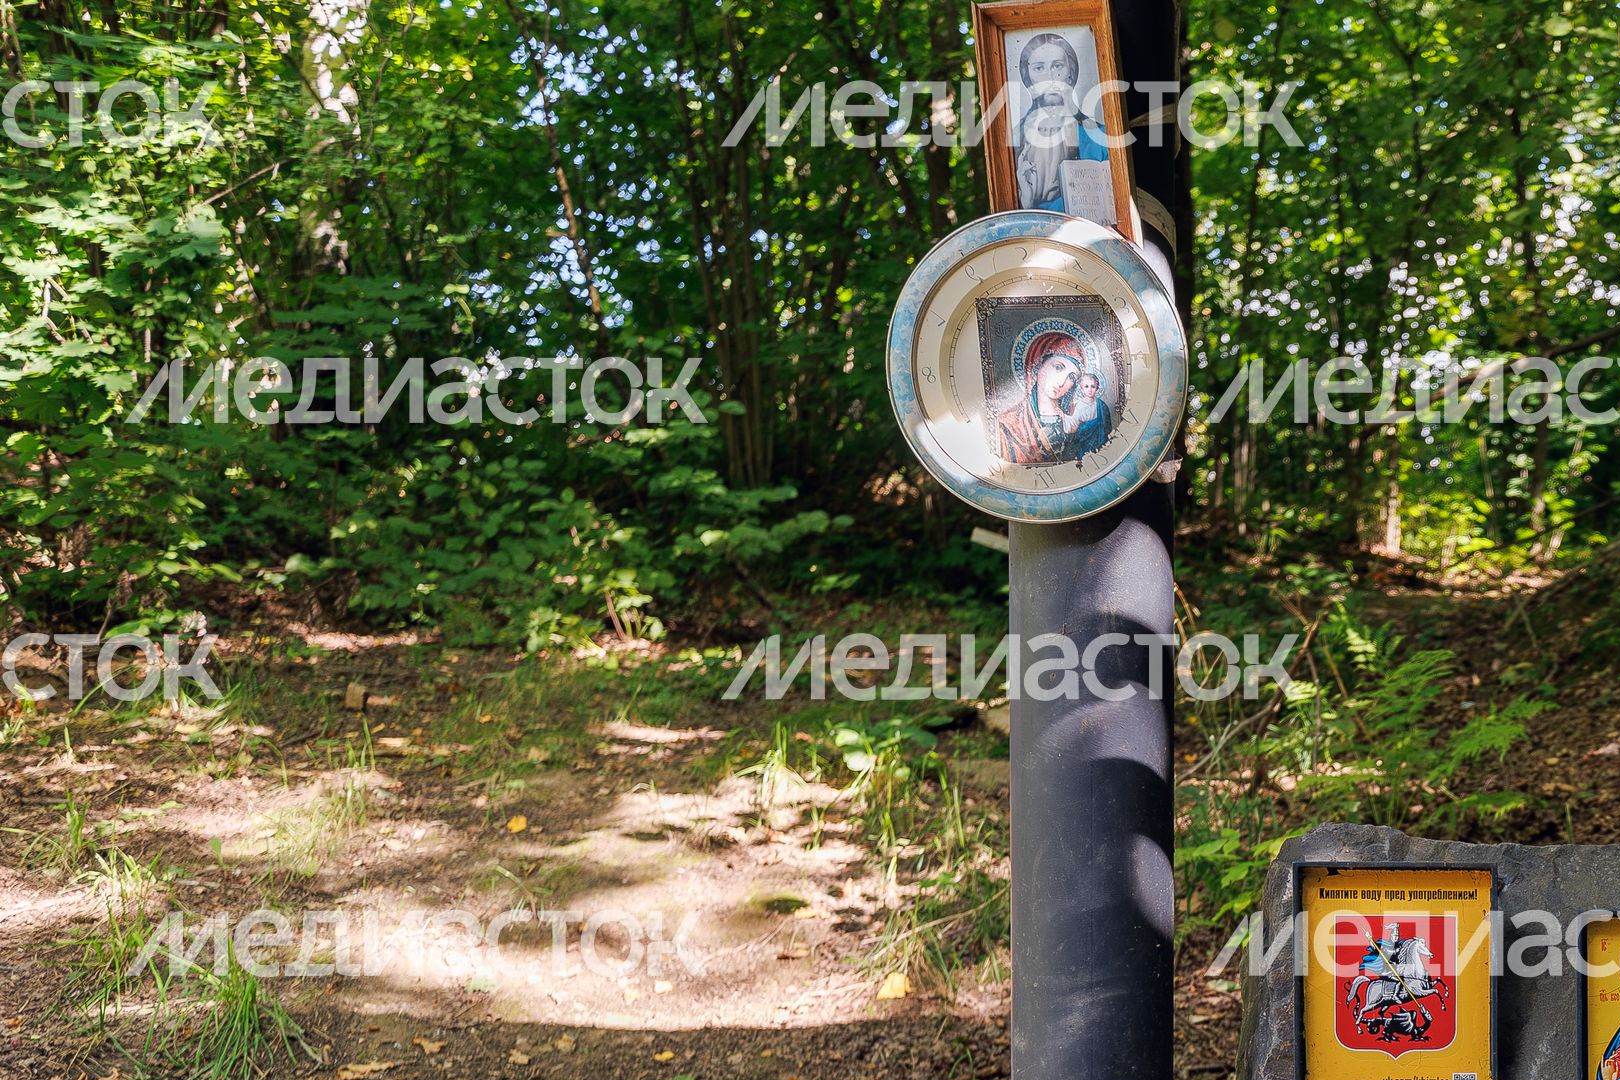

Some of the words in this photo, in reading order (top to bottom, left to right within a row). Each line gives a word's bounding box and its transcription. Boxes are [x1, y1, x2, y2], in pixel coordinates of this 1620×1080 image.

[1319, 888, 1358, 900] Кипятите
[1361, 889, 1382, 901] воду
[1385, 889, 1406, 901] пред
[1408, 887, 1478, 901] употреблением!
